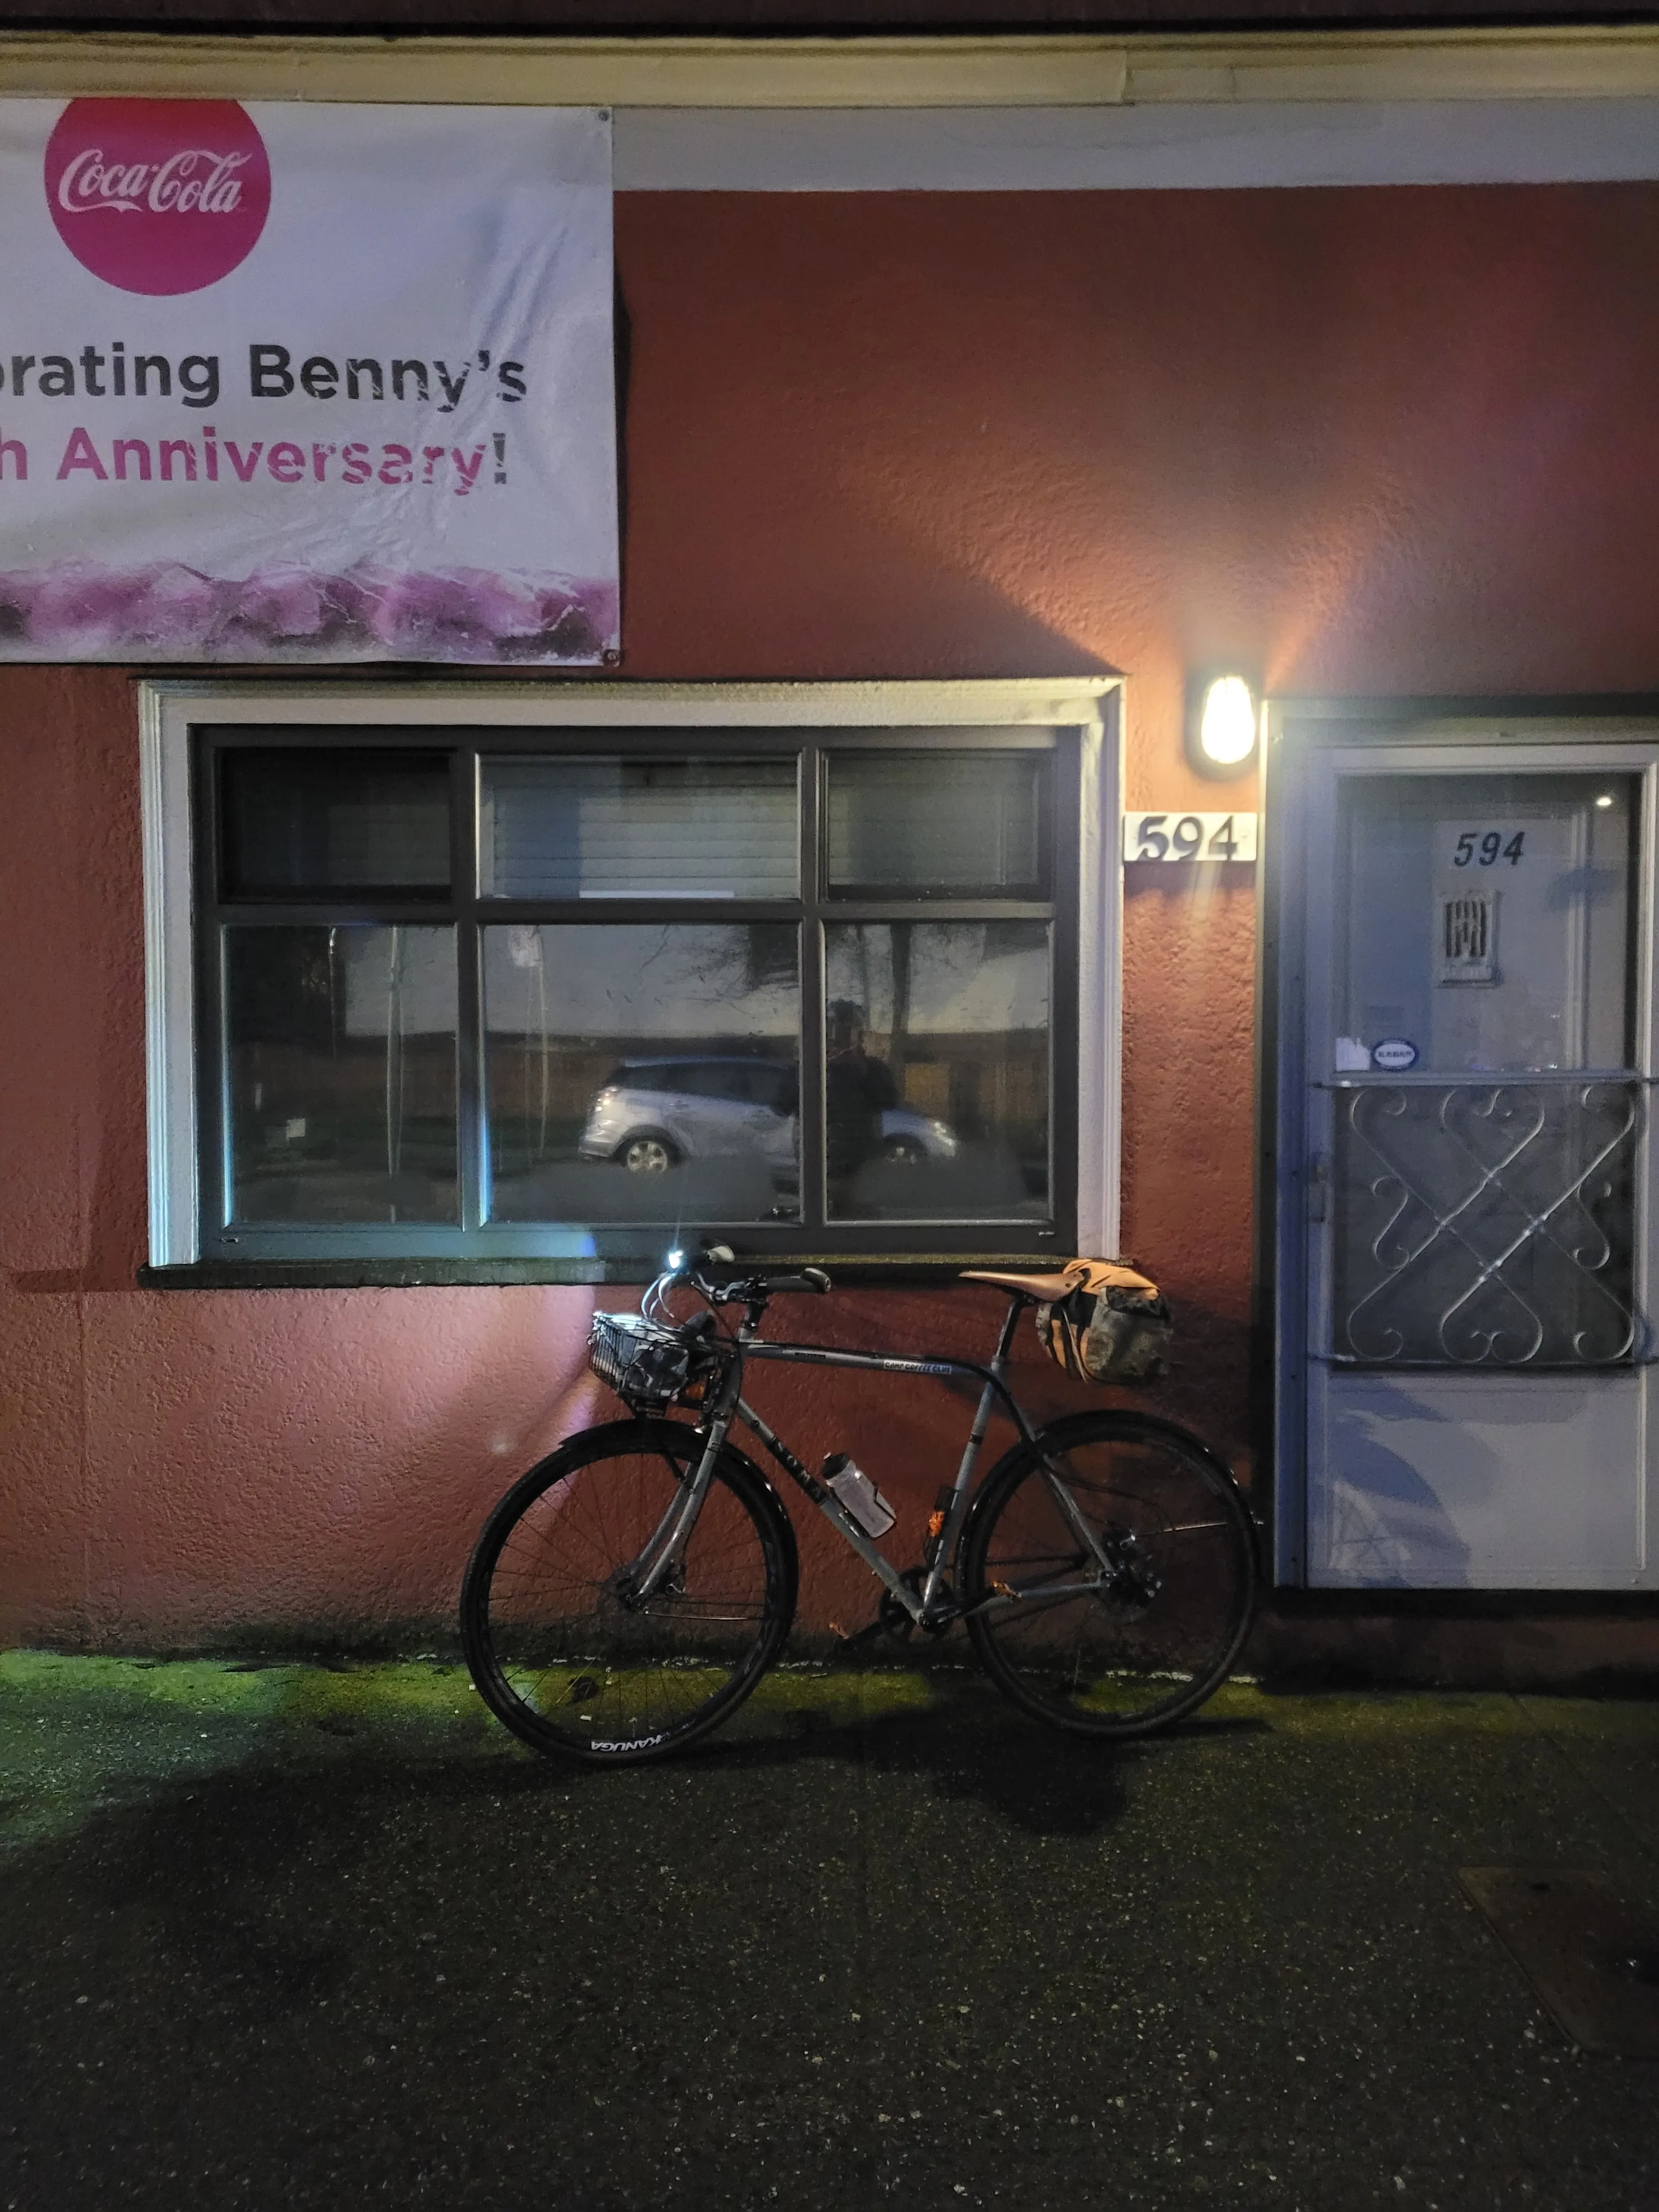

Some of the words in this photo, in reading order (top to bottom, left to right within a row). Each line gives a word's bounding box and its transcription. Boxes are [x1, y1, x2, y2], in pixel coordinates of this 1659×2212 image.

[59, 149, 252, 212] Coca-Cola
[0, 342, 220, 408] rating
[249, 344, 527, 413] Benny's
[57, 426, 507, 495] Anniversary!
[1137, 816, 1239, 861] 594
[1454, 831, 1525, 866] 594
[591, 1734, 664, 1752] KANUGA
